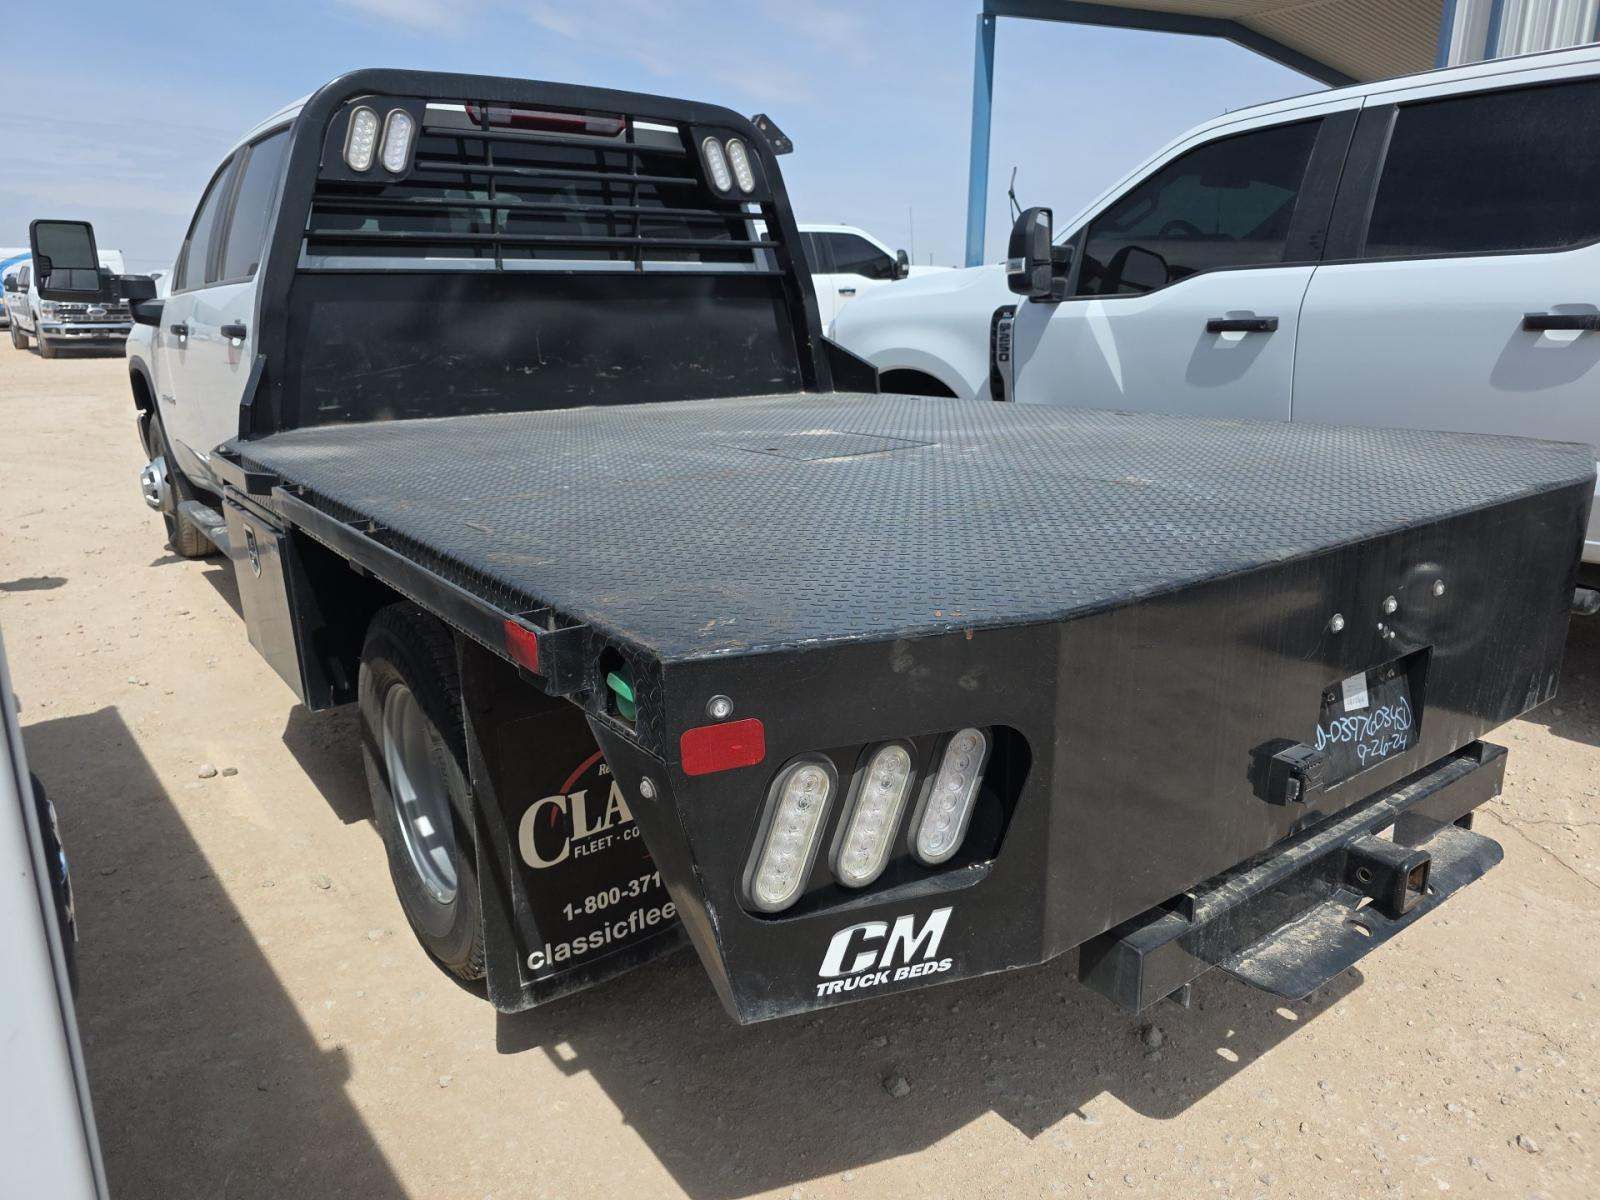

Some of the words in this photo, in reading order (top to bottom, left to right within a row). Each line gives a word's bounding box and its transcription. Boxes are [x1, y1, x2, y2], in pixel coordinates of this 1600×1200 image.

[1357, 733, 1408, 766] 9-26-24
[518, 780, 634, 869] CLA
[574, 834, 613, 859] FLEET
[623, 826, 640, 841] CO
[563, 870, 661, 921] 1-800-371
[527, 901, 676, 971] classicflee
[818, 906, 954, 977] CM
[816, 970, 892, 997] TRUCK
[893, 958, 954, 982] BEDS
